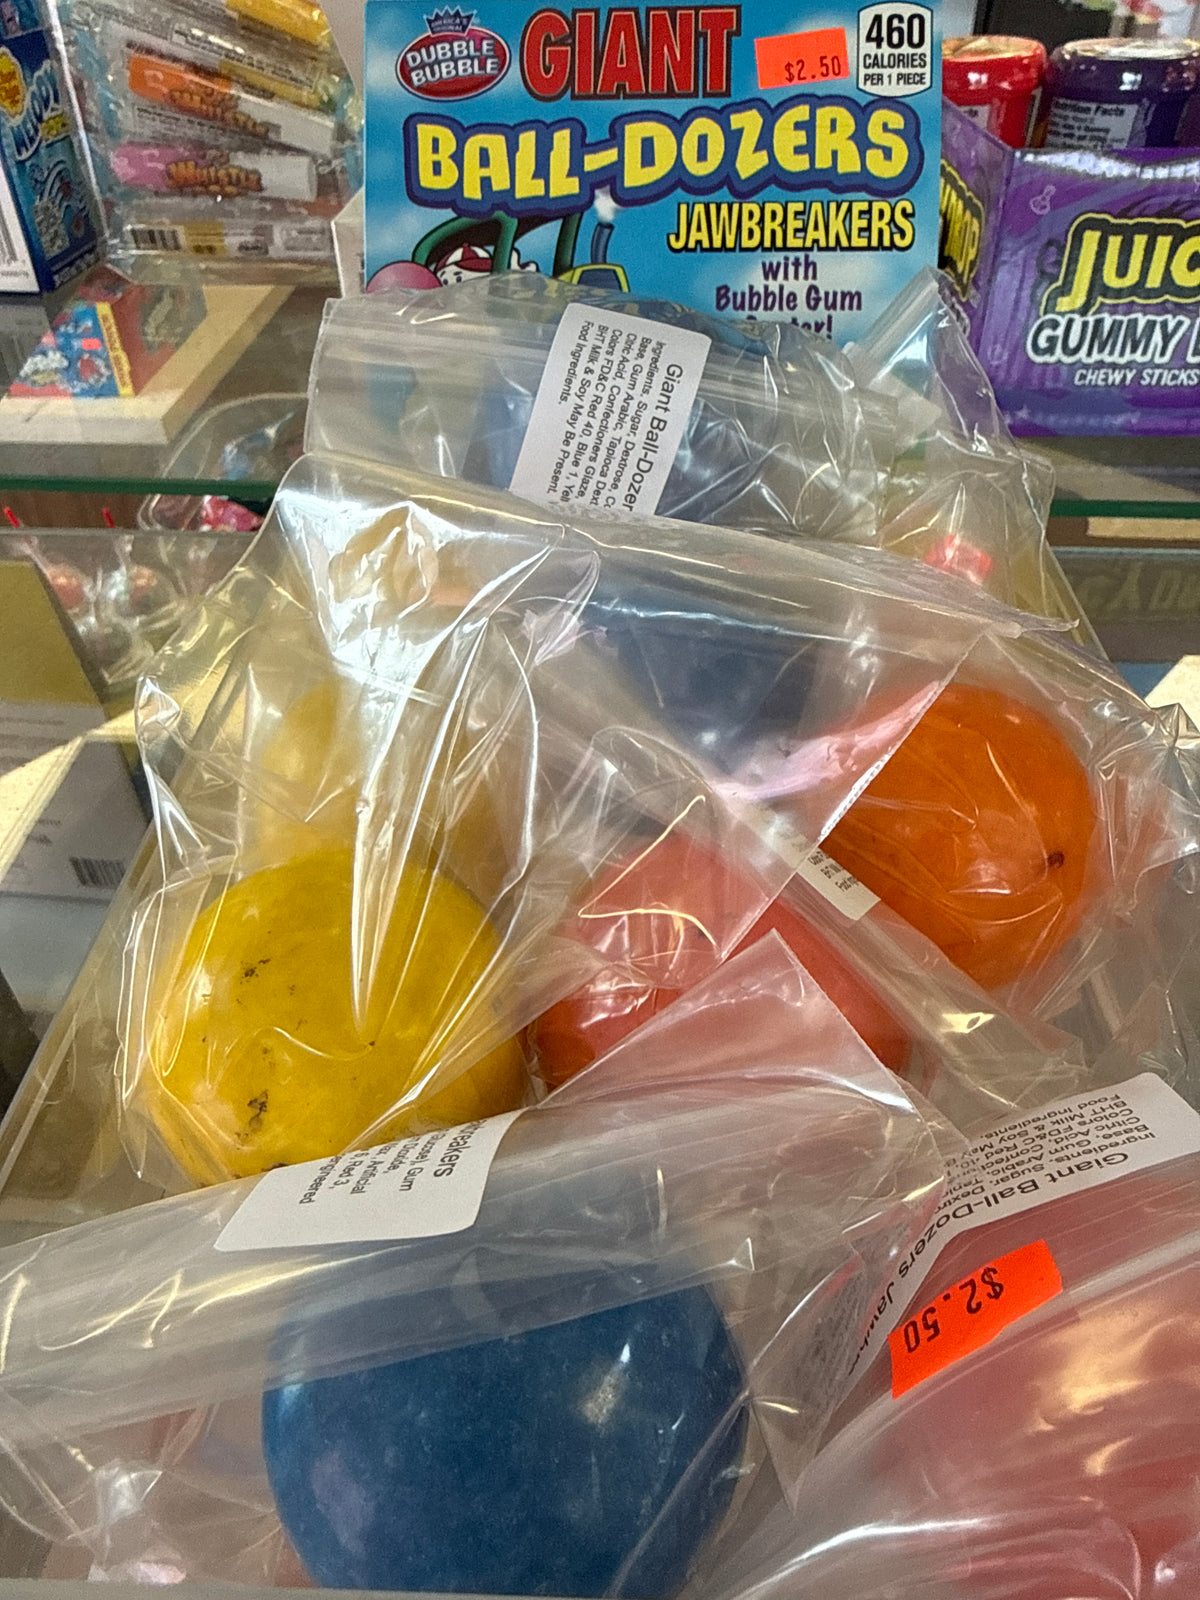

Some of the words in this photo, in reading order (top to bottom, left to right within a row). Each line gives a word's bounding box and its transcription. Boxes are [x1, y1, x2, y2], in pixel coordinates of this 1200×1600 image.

[865, 13, 926, 49] 460
[405, 39, 496, 68] DUBBLE
[522, 7, 739, 97] GIANT
[863, 53, 927, 70] CALORIES
[411, 57, 499, 87] BUBBLE
[784, 55, 842, 84] $2.50
[864, 74, 883, 86] PER
[887, 74, 893, 85] 1
[896, 73, 926, 86] PIECE
[415, 103, 910, 201] BALL-DOZERS
[668, 199, 915, 251] JAWBREAKERS
[762, 253, 818, 282] with
[715, 284, 798, 312] Bubble
[805, 285, 862, 311] Gum
[578, 321, 594, 342] Food
[595, 325, 609, 344] BHT
[606, 330, 622, 356] Colors
[622, 333, 637, 354] Citric
[1028, 315, 1186, 362] GUMMY
[588, 344, 602, 364] Milk
[635, 337, 652, 360] Base,
[559, 343, 586, 404] Ingredients.
[596, 358, 613, 392] FD&C
[613, 355, 630, 380] Acid,
[628, 364, 643, 390] Gum
[1074, 369, 1136, 386] CHEWY
[1140, 368, 1200, 386] STICKS
[575, 378, 591, 401] Soy
[655, 364, 683, 412] Giant
[566, 404, 584, 428] May
[587, 394, 602, 419] Red
[613, 392, 634, 430] Arabic,
[627, 401, 648, 436] Sugar,
[580, 421, 593, 437] 40,
[589, 385, 620, 462] Confectioners
[563, 431, 576, 446] Be
[572, 442, 588, 467] Blue
[600, 437, 622, 478] Tapioca
[608, 441, 635, 492] Dextrose,
[623, 416, 667, 511] Ball-Dozer
[575, 466, 595, 498] Glaze,
[1078, 1094, 1120, 1110] Food
[1091, 1101, 1126, 1116] BHT
[980, 1108, 1072, 1139] Ingredients.
[1050, 1113, 1084, 1125] Milk
[1078, 1108, 1133, 1126] Colors
[1094, 1117, 1140, 1131] Citric
[999, 1130, 1028, 1144] Soy
[1022, 1125, 1073, 1145] FD&C
[1048, 1129, 1090, 1144] Acid,
[1096, 1124, 1149, 1139] Base,
[985, 1143, 1018, 1160] Red
[1049, 1140, 1091, 1154] Gum
[339, 1160, 364, 1178] Red
[987, 1153, 1043, 1176] Arabic,
[1045, 1153, 1128, 1182] Giant
[328, 1179, 350, 1189] 3,
[350, 1160, 384, 1195] Artificial
[399, 1167, 424, 1191] Gum
[899, 1178, 1040, 1279] Ball-Dozers
[903, 1265, 1004, 1353] $2.50
